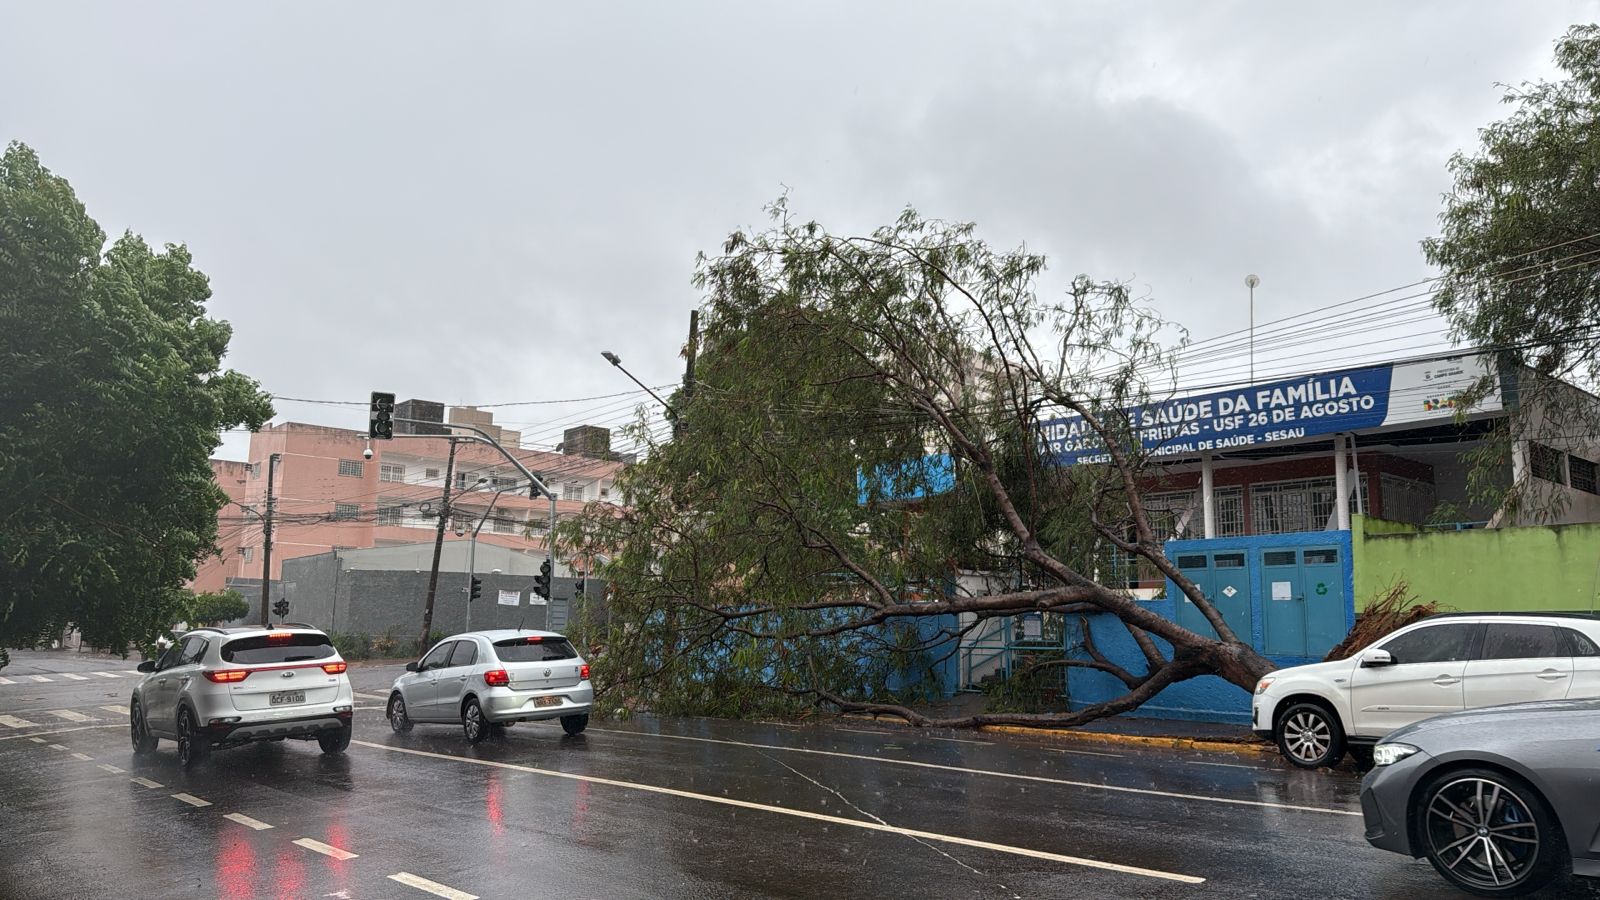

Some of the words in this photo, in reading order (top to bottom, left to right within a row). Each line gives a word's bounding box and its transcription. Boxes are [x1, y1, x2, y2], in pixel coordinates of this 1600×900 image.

[1140, 422, 1200, 440] FREITAS
[1213, 418, 1244, 432] USF
[1249, 412, 1268, 427] 26
[1272, 407, 1296, 423] DE
[1300, 395, 1375, 418] AGOSTO
[1141, 401, 1213, 426] SAÚDE
[1218, 394, 1252, 416] DA
[1256, 376, 1358, 410] FAMÍLIA
[1198, 440, 1214, 451] DE
[1216, 434, 1255, 449] SAÚDE
[1265, 427, 1305, 442] SESAU
